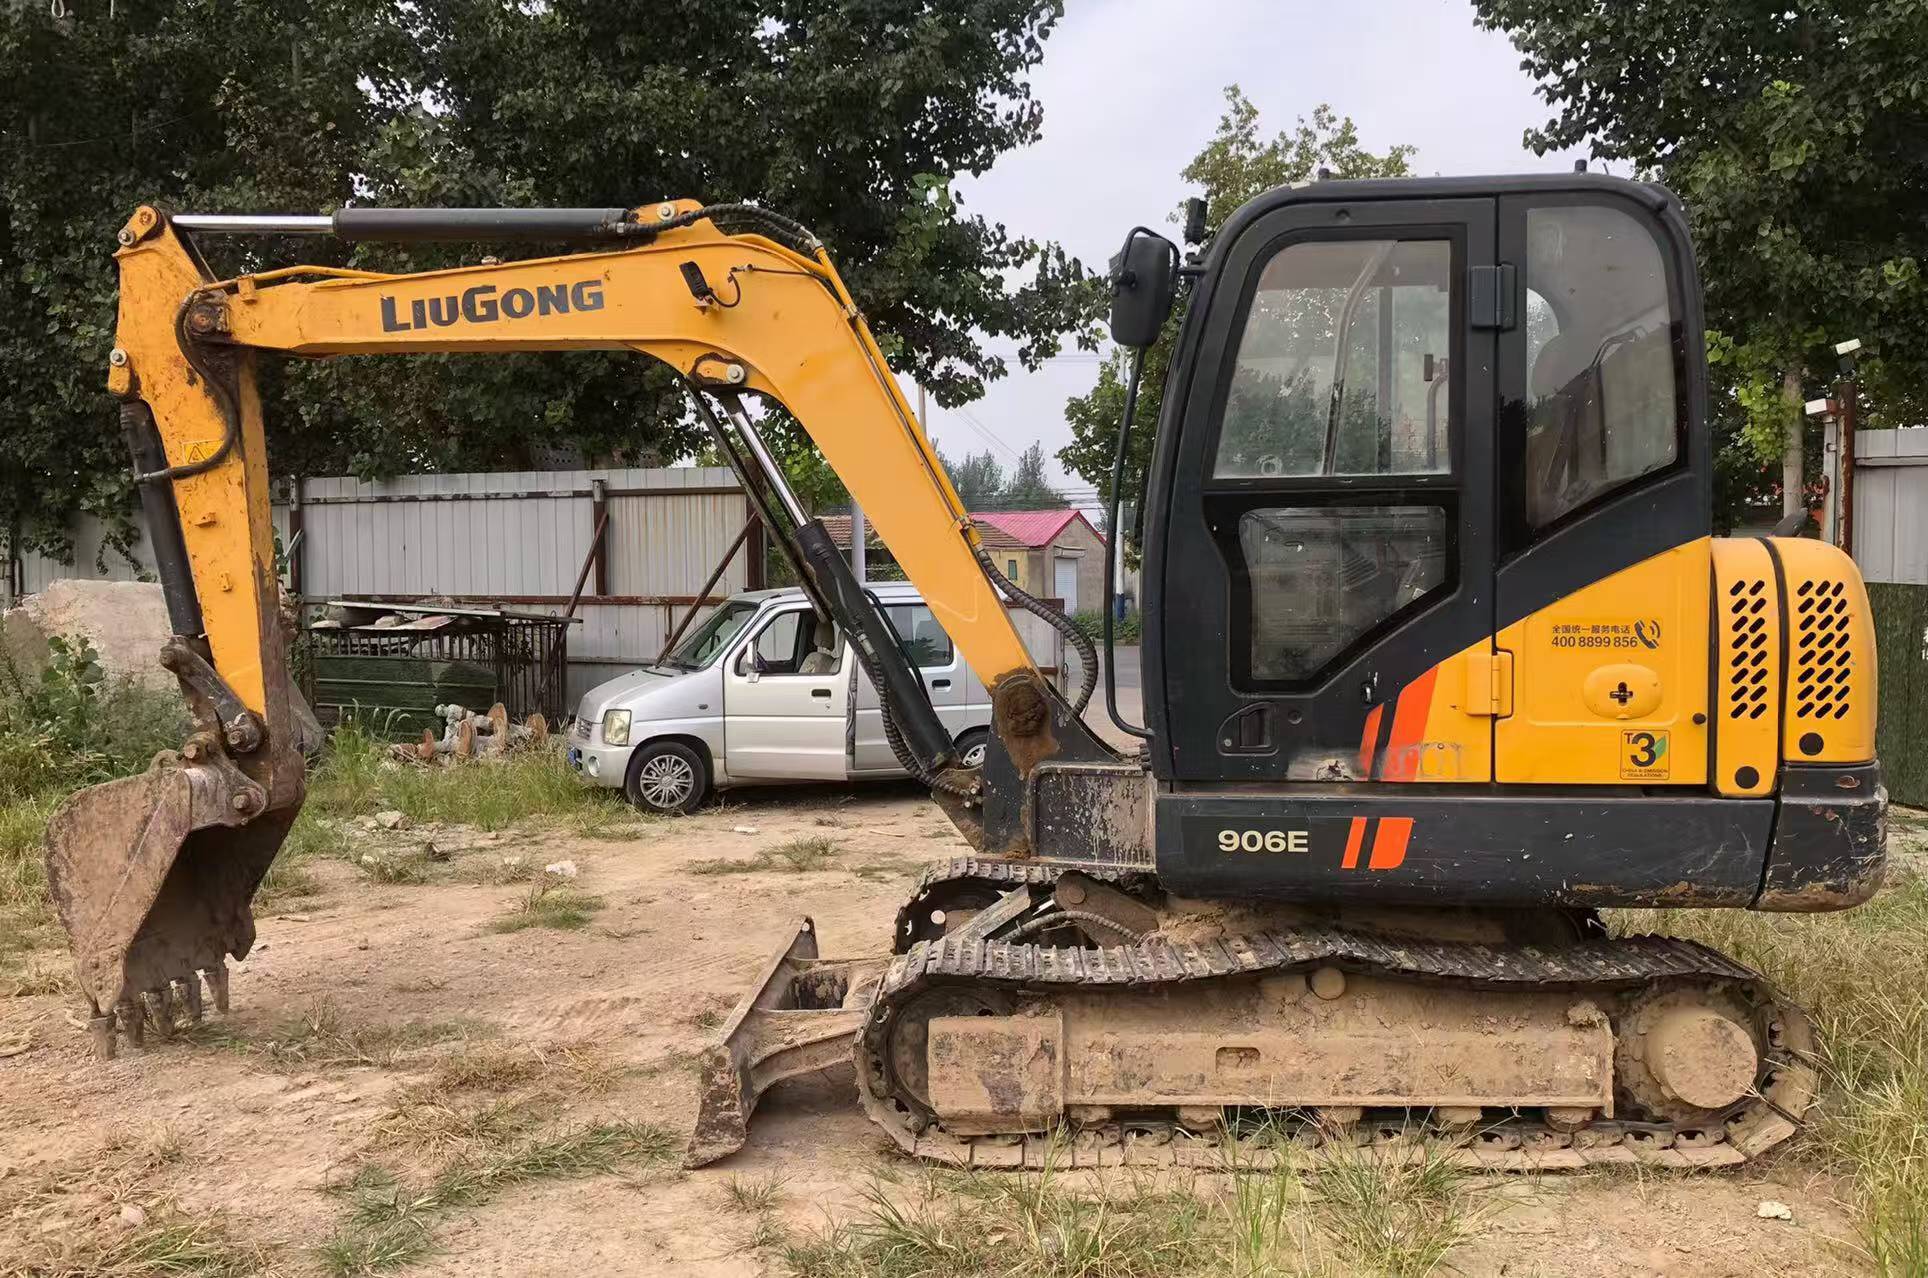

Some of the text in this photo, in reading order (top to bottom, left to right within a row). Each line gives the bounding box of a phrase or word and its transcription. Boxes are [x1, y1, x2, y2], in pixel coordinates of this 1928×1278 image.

[1552, 624, 1631, 634] 全国统一服务电话
[1551, 635, 1638, 648] 400 8899 856
[1217, 829, 1309, 853] 906E
